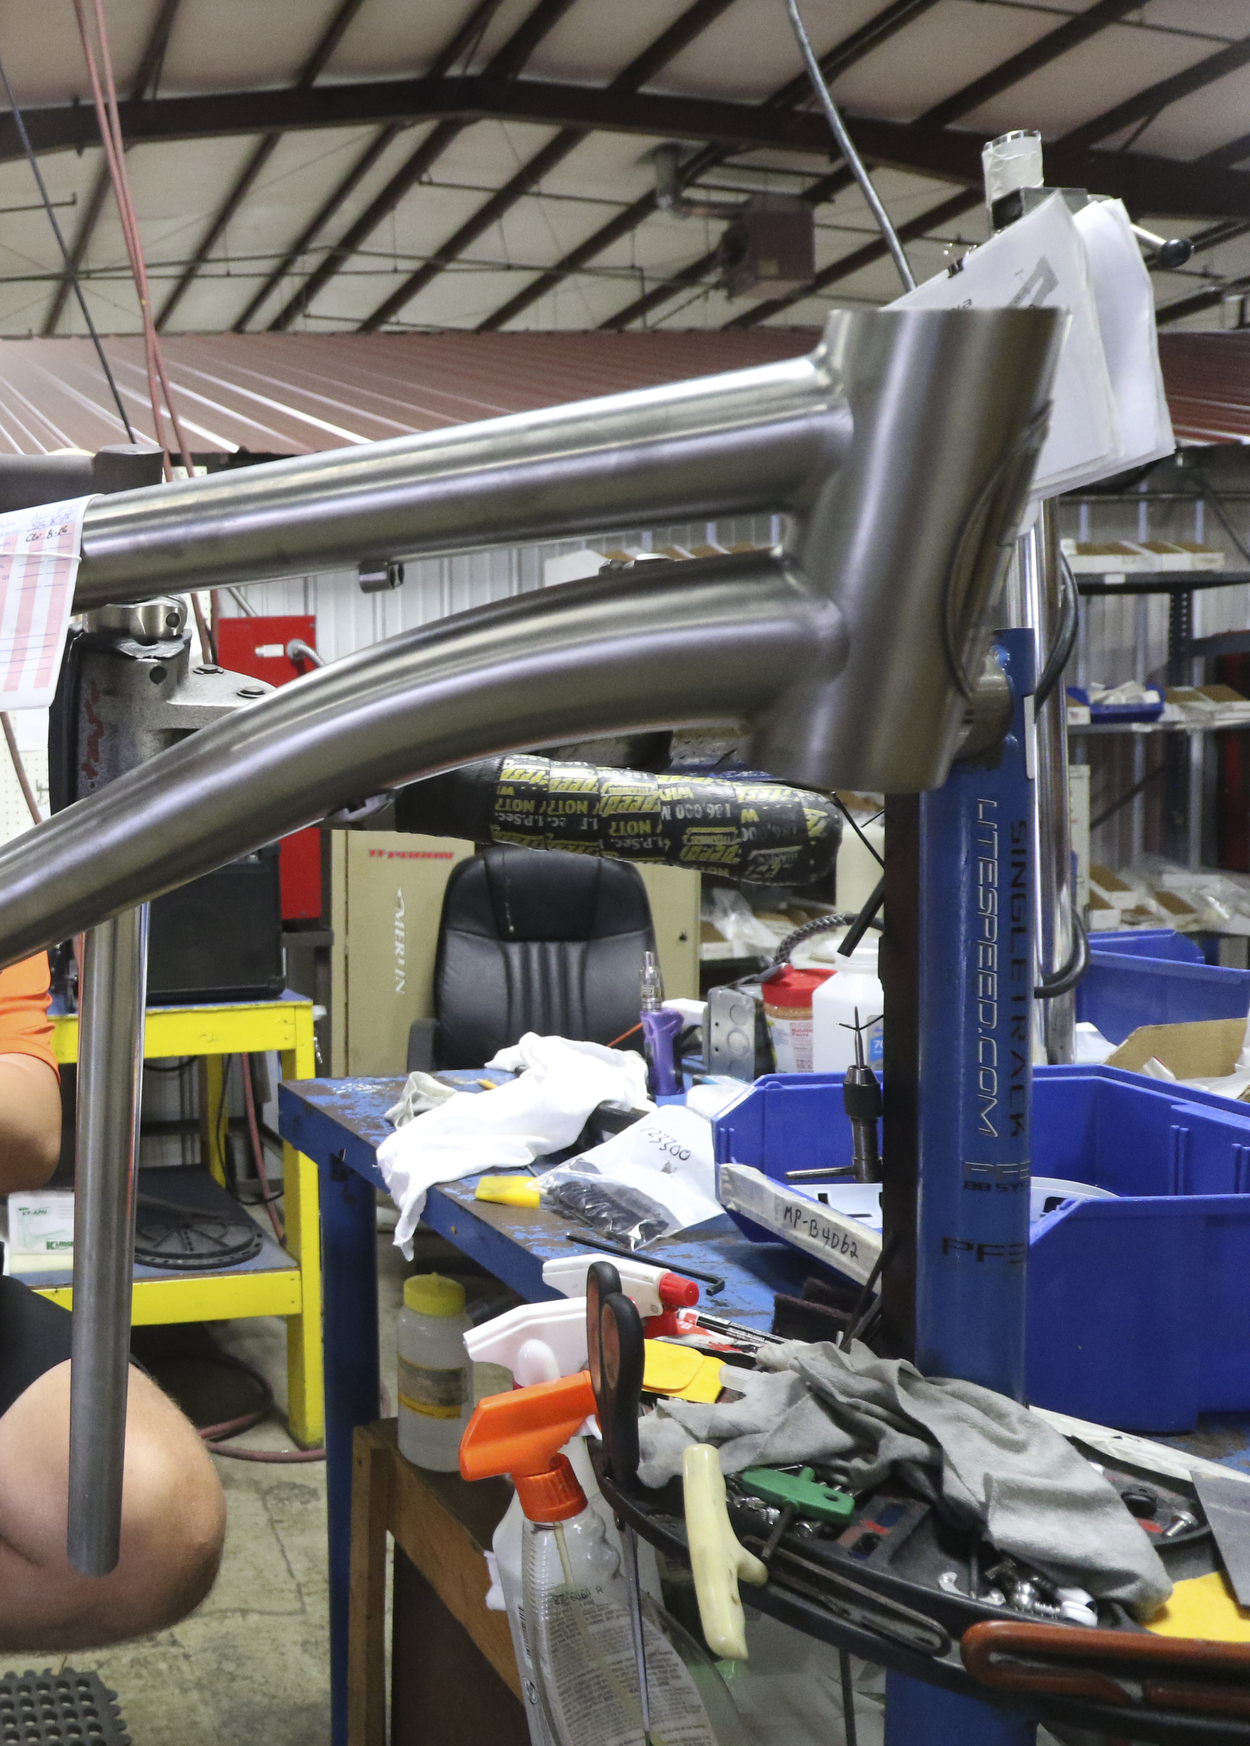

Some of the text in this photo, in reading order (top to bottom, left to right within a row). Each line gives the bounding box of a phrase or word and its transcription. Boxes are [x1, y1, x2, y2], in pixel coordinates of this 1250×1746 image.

[494, 798, 536, 814] NOT?
[547, 800, 589, 815] NOT?
[608, 819, 652, 837] NOT?
[977, 798, 999, 1138] LITESPEED.COM
